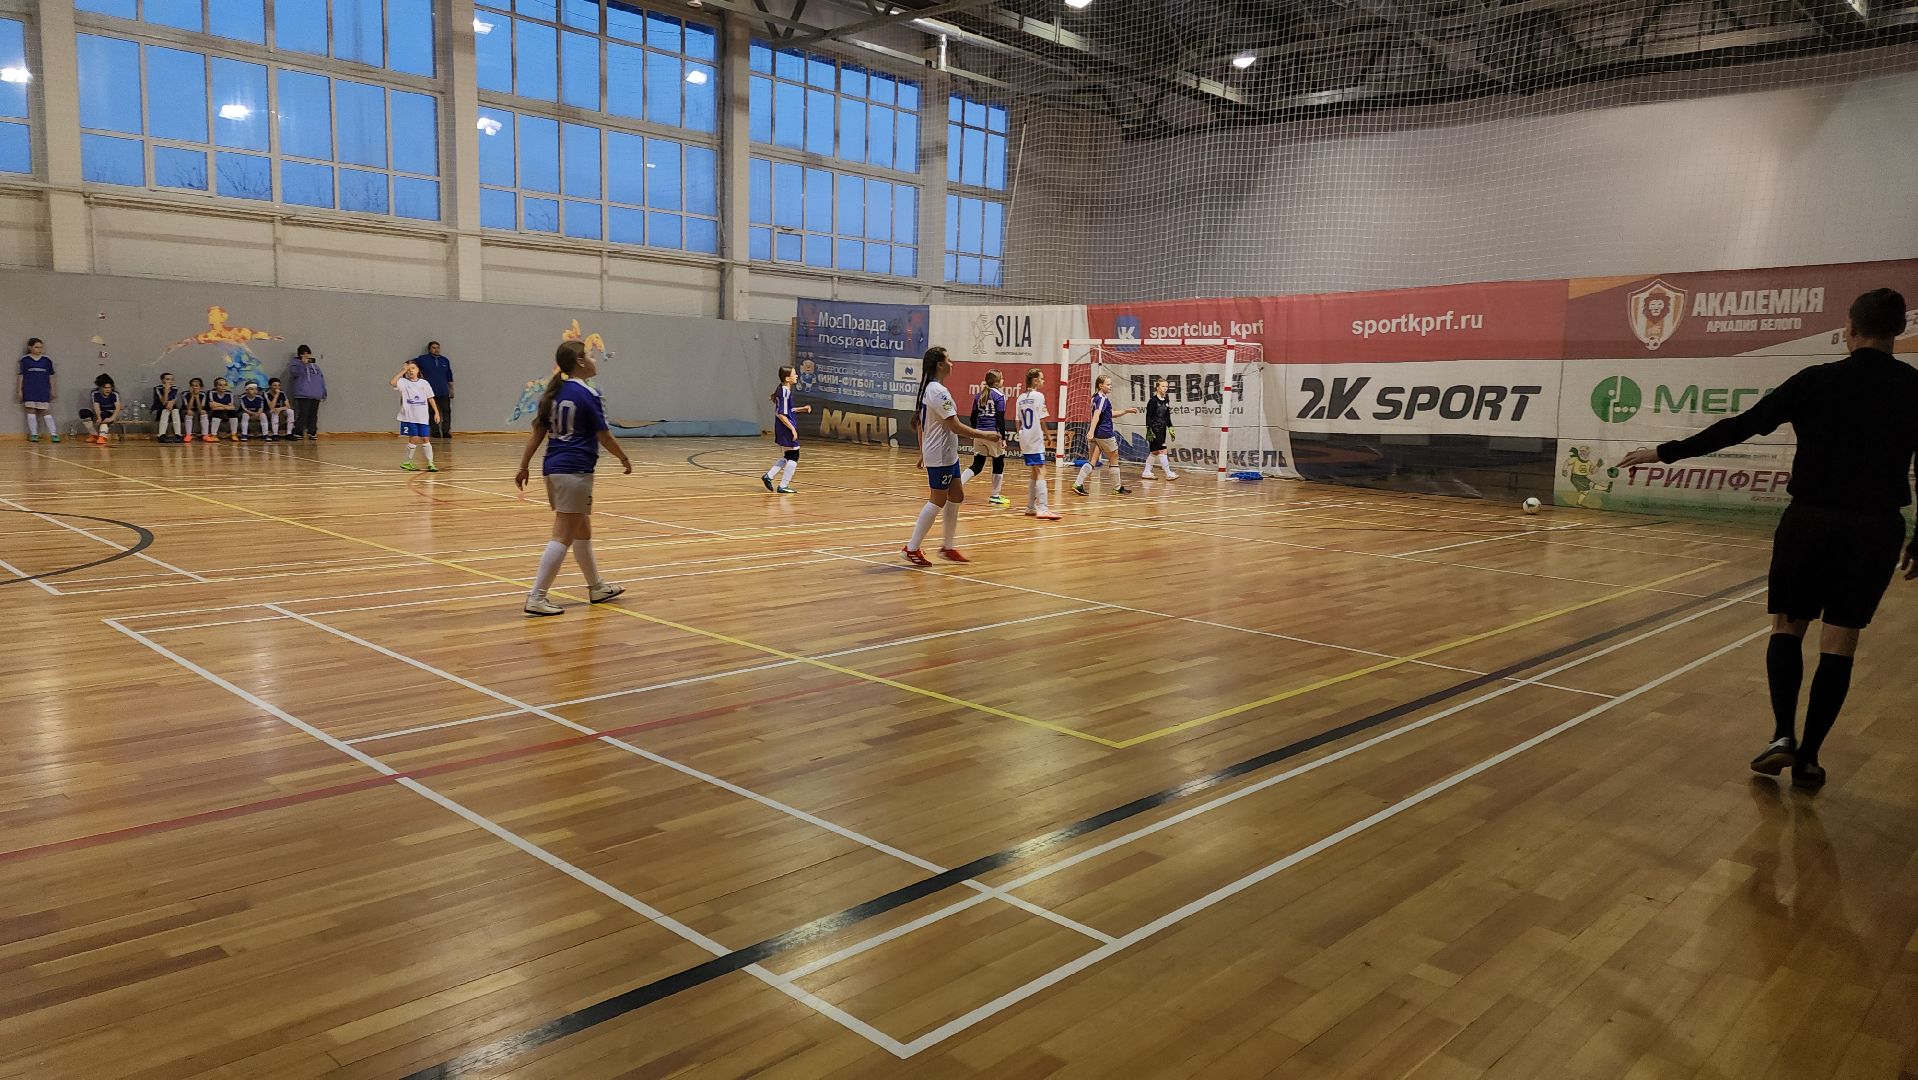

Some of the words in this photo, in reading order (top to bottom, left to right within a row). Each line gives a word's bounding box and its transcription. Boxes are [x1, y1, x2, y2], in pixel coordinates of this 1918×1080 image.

[1691, 287, 1825, 317] АКАДЕМИЯ
[818, 311, 887, 335] МосПравда
[995, 314, 1032, 347] SILA
[1351, 311, 1483, 338] sportkprf.ru
[1706, 319, 1757, 333] АРКАДИЯ
[1760, 317, 1802, 331] БЕЛОГО
[818, 333, 904, 351] mospravda.ru
[1372, 385, 1542, 422] SPORT
[820, 407, 900, 449] МАТЧ!
